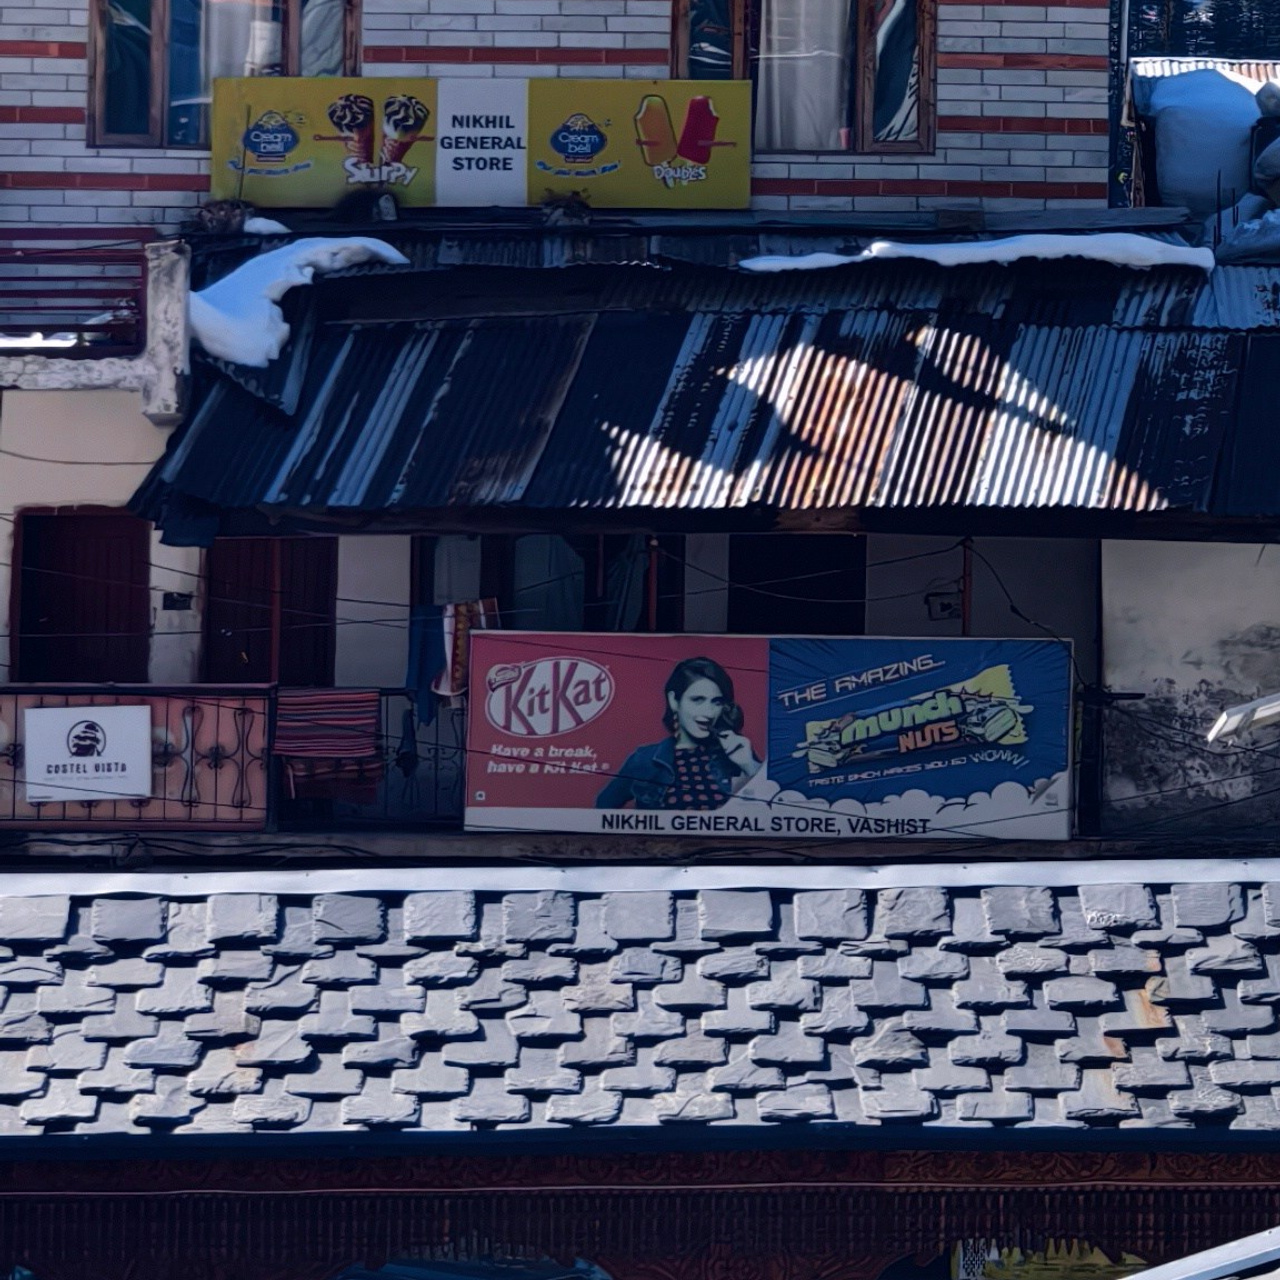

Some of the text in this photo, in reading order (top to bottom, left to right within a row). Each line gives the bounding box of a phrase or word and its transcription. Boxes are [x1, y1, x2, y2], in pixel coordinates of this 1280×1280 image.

[451, 114, 515, 129] NIKHIL
[440, 136, 527, 150] GENERAL
[558, 131, 599, 143] Cream
[567, 142, 592, 153] bell
[452, 156, 514, 171] STORE
[778, 683, 827, 707] THE
[897, 719, 960, 754] NUTS
[490, 743, 530, 758] Have
[533, 747, 544, 758] a
[486, 760, 526, 774] have
[601, 814, 931, 836] NIKHIL GENERAL STORE, VASHIST
